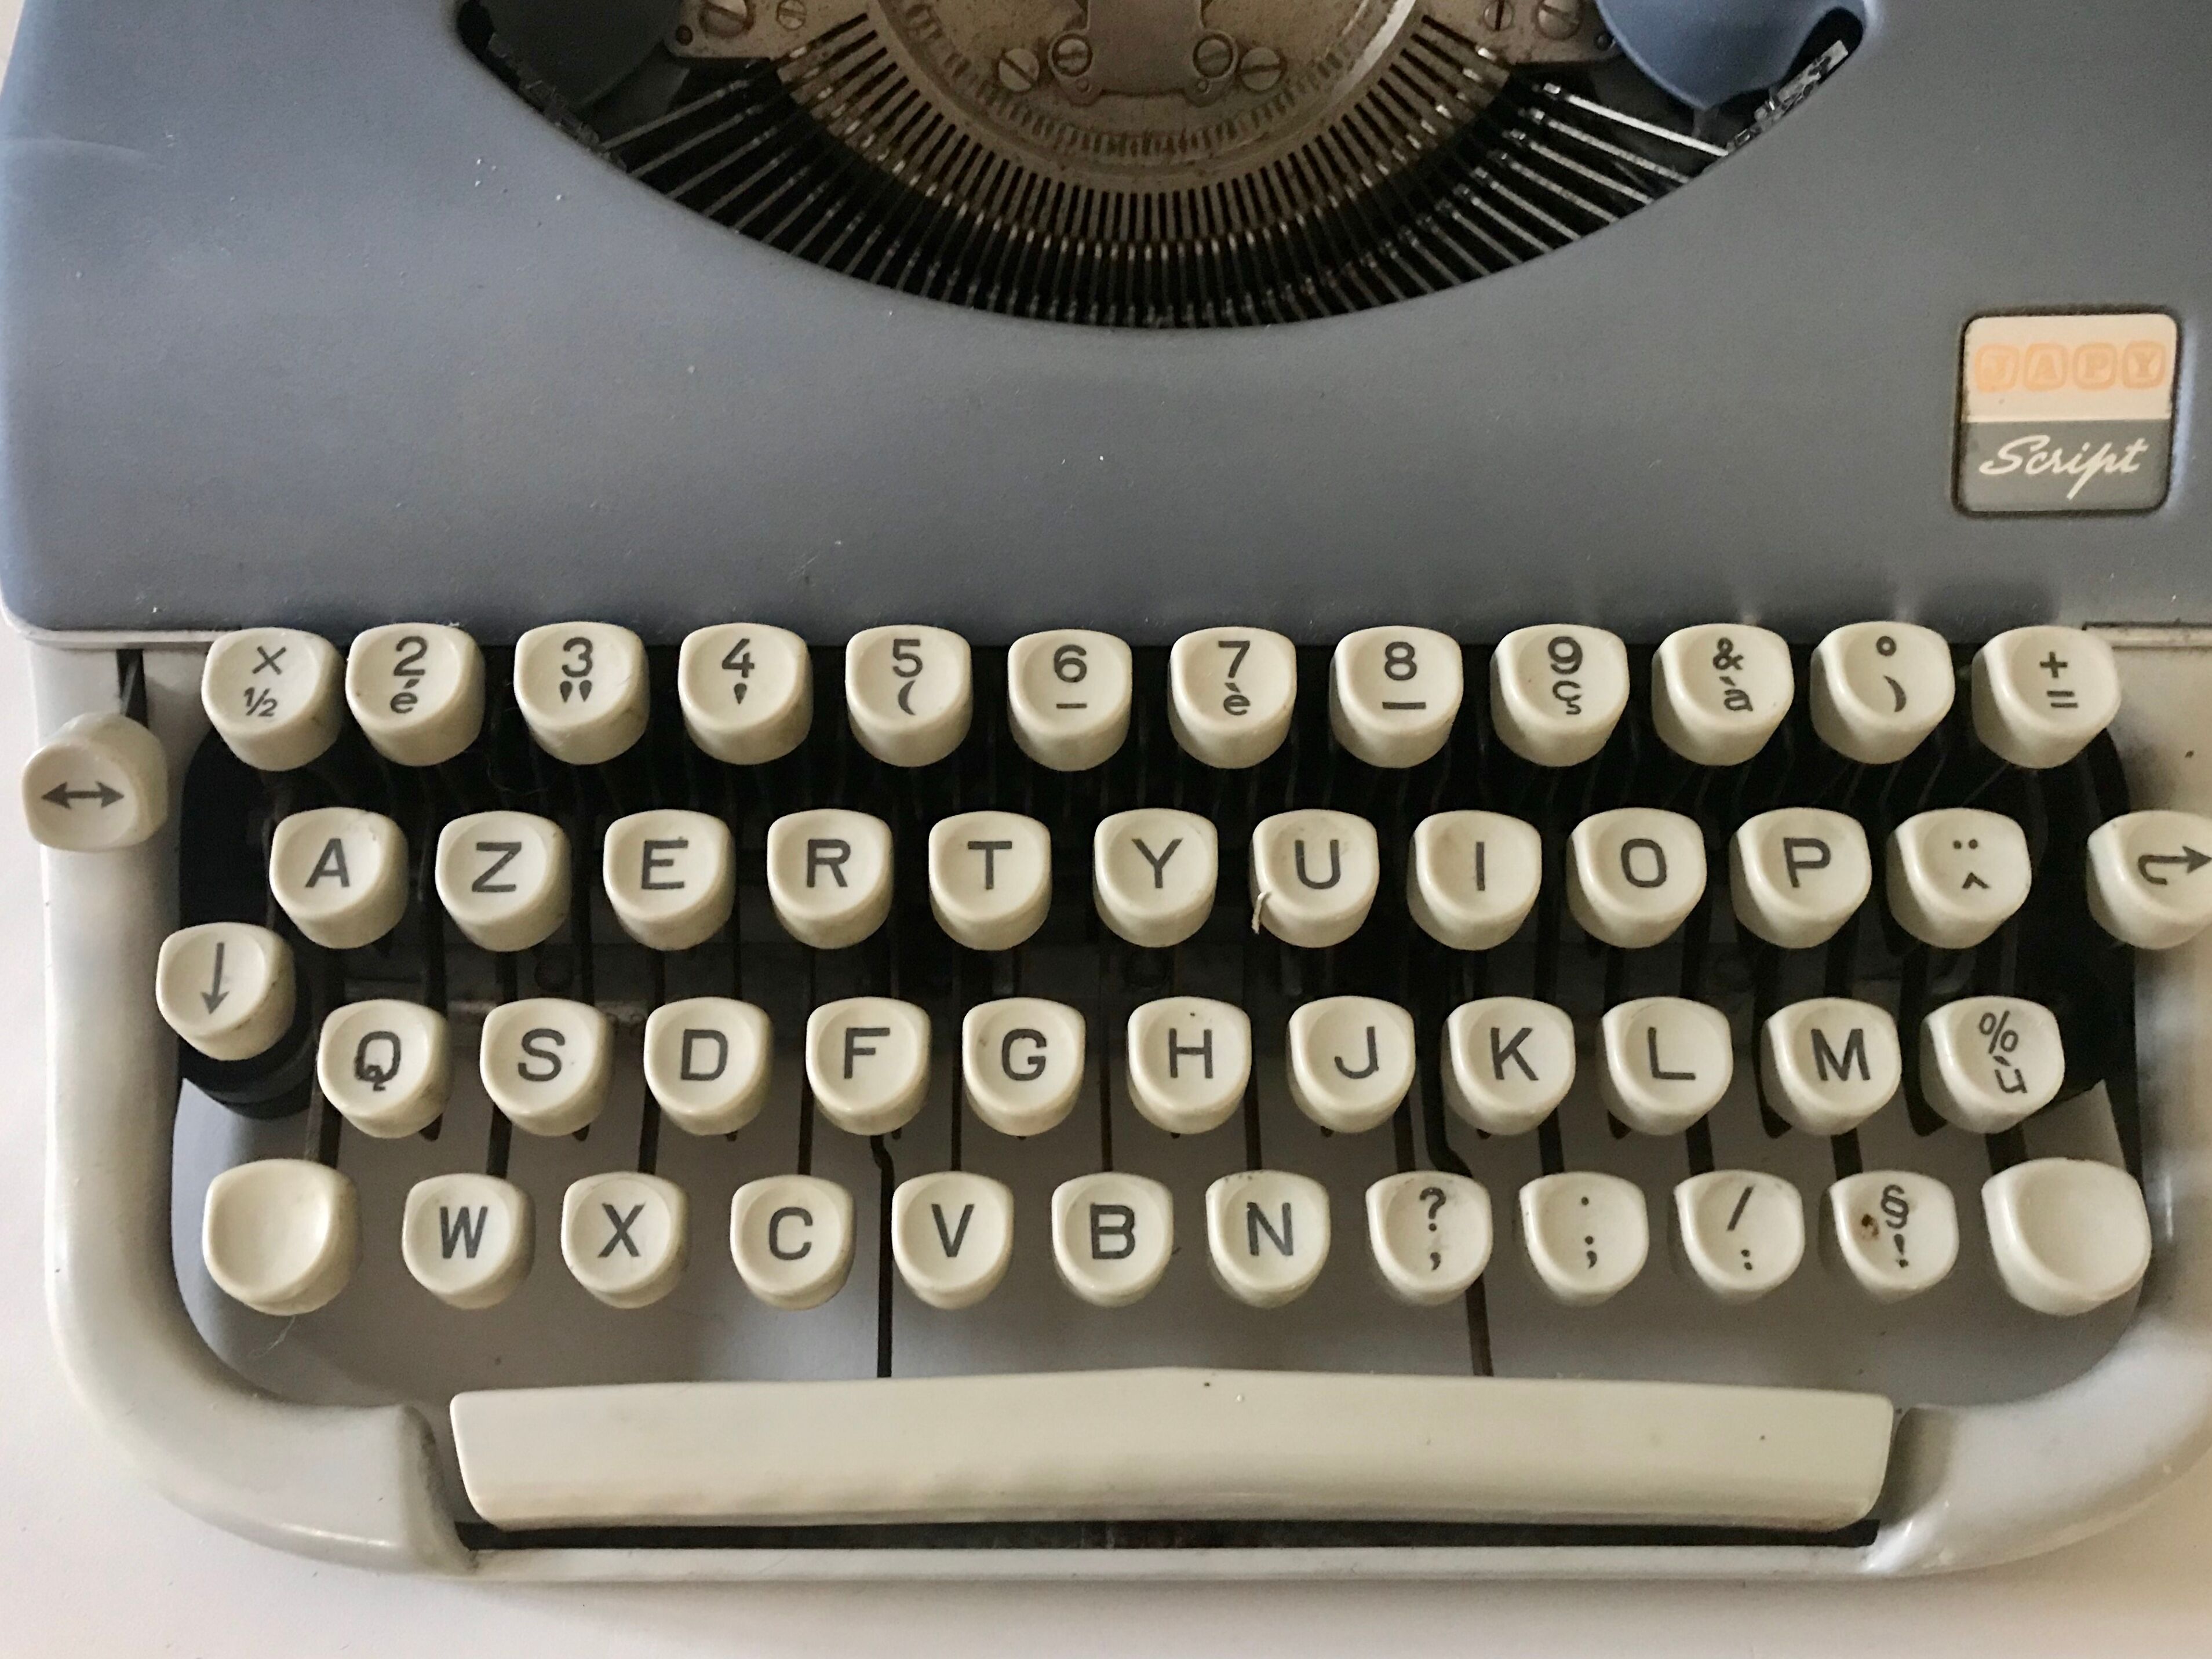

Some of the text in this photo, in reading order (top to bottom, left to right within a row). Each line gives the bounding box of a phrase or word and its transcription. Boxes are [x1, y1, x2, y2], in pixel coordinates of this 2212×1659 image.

[1976, 342, 2165, 391] JAPY
[1979, 434, 2149, 501] Script
[393, 635, 428, 676] 2
[561, 637, 593, 678] 3
[721, 638, 755, 679] 4
[892, 638, 923, 678] 5
[1053, 644, 1087, 683] 6
[1218, 640, 1251, 679] 7
[1384, 641, 1417, 681] 8
[1548, 636, 1584, 675] 9
[1712, 636, 1745, 671] &
[2039, 651, 2068, 679] +
[390, 678, 420, 714] é
[1223, 682, 1251, 716] è
[1552, 680, 1583, 715] ç
[1719, 676, 1754, 712] à
[2046, 690, 2079, 709] =
[304, 838, 350, 888] A
[471, 841, 522, 893] Z
[641, 838, 688, 891] E
[806, 838, 851, 888] R
[967, 840, 1012, 891] T
[1131, 838, 1182, 889] Y
[1294, 839, 1341, 890] U
[1475, 841, 1486, 892] I
[1620, 838, 1667, 889] O
[1783, 837, 1831, 889] P
[517, 1028, 566, 1082] S
[680, 1028, 728, 1081] D
[843, 1027, 890, 1080] F
[1001, 1028, 1047, 1082] G
[1168, 1027, 1213, 1079] H
[1333, 1026, 1379, 1080] J
[1489, 1026, 1539, 1081] K
[1646, 1026, 1696, 1081] L
[1810, 1027, 1871, 1082] M
[1978, 1010, 2019, 1053] %
[354, 1030, 401, 1092] Q
[439, 1206, 488, 1259] W
[597, 1202, 644, 1258] X
[768, 1206, 813, 1261] C
[931, 1203, 974, 1258] V
[1089, 1202, 1136, 1260] B
[1246, 1201, 1293, 1257] N
[1419, 1187, 1446, 1232] ?
[1726, 1186, 1754, 1232] /
